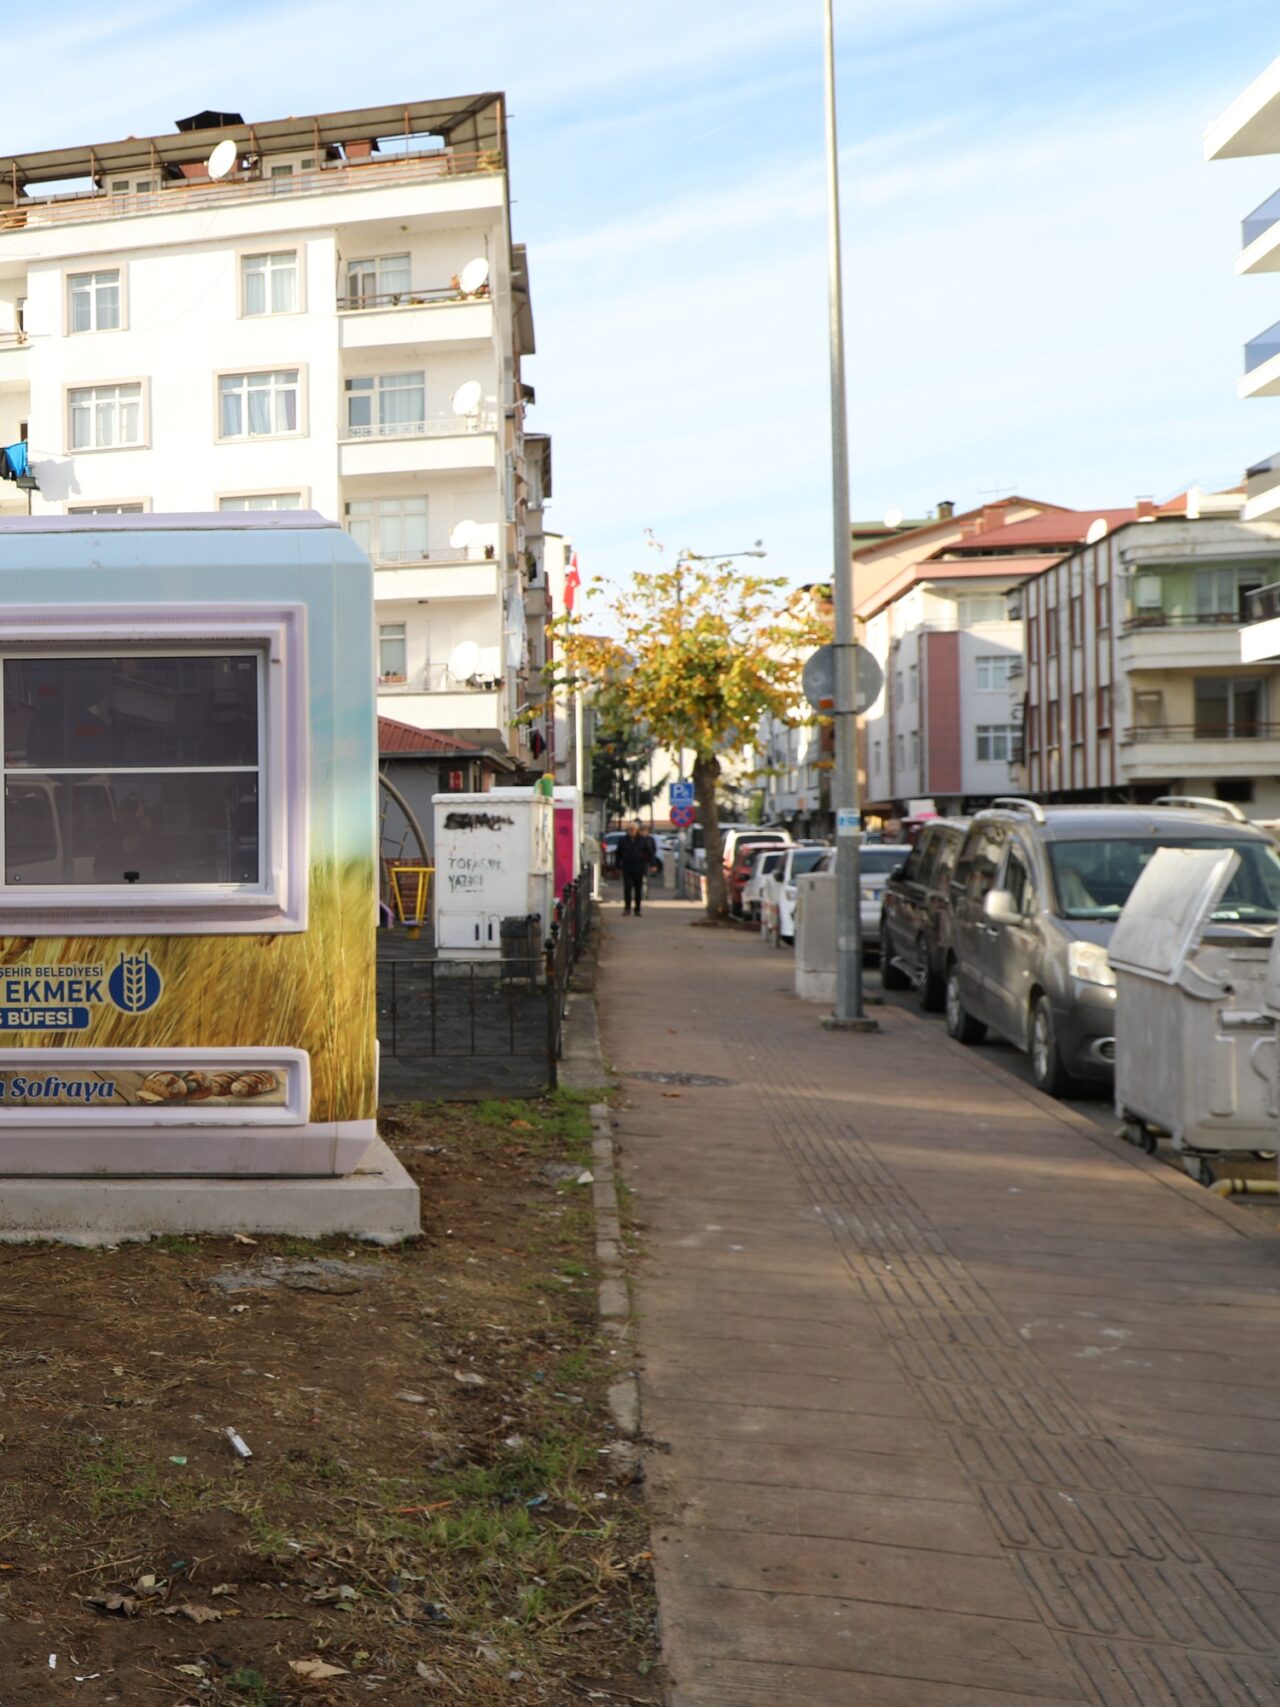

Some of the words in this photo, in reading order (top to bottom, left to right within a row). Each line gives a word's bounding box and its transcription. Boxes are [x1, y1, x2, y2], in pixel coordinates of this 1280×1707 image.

[36, 964, 103, 978] BELEDİYESİ
[6, 980, 103, 1003] EKMEK
[8, 1008, 73, 1026] BÜFESİ
[10, 1076, 114, 1101] Sofraya
